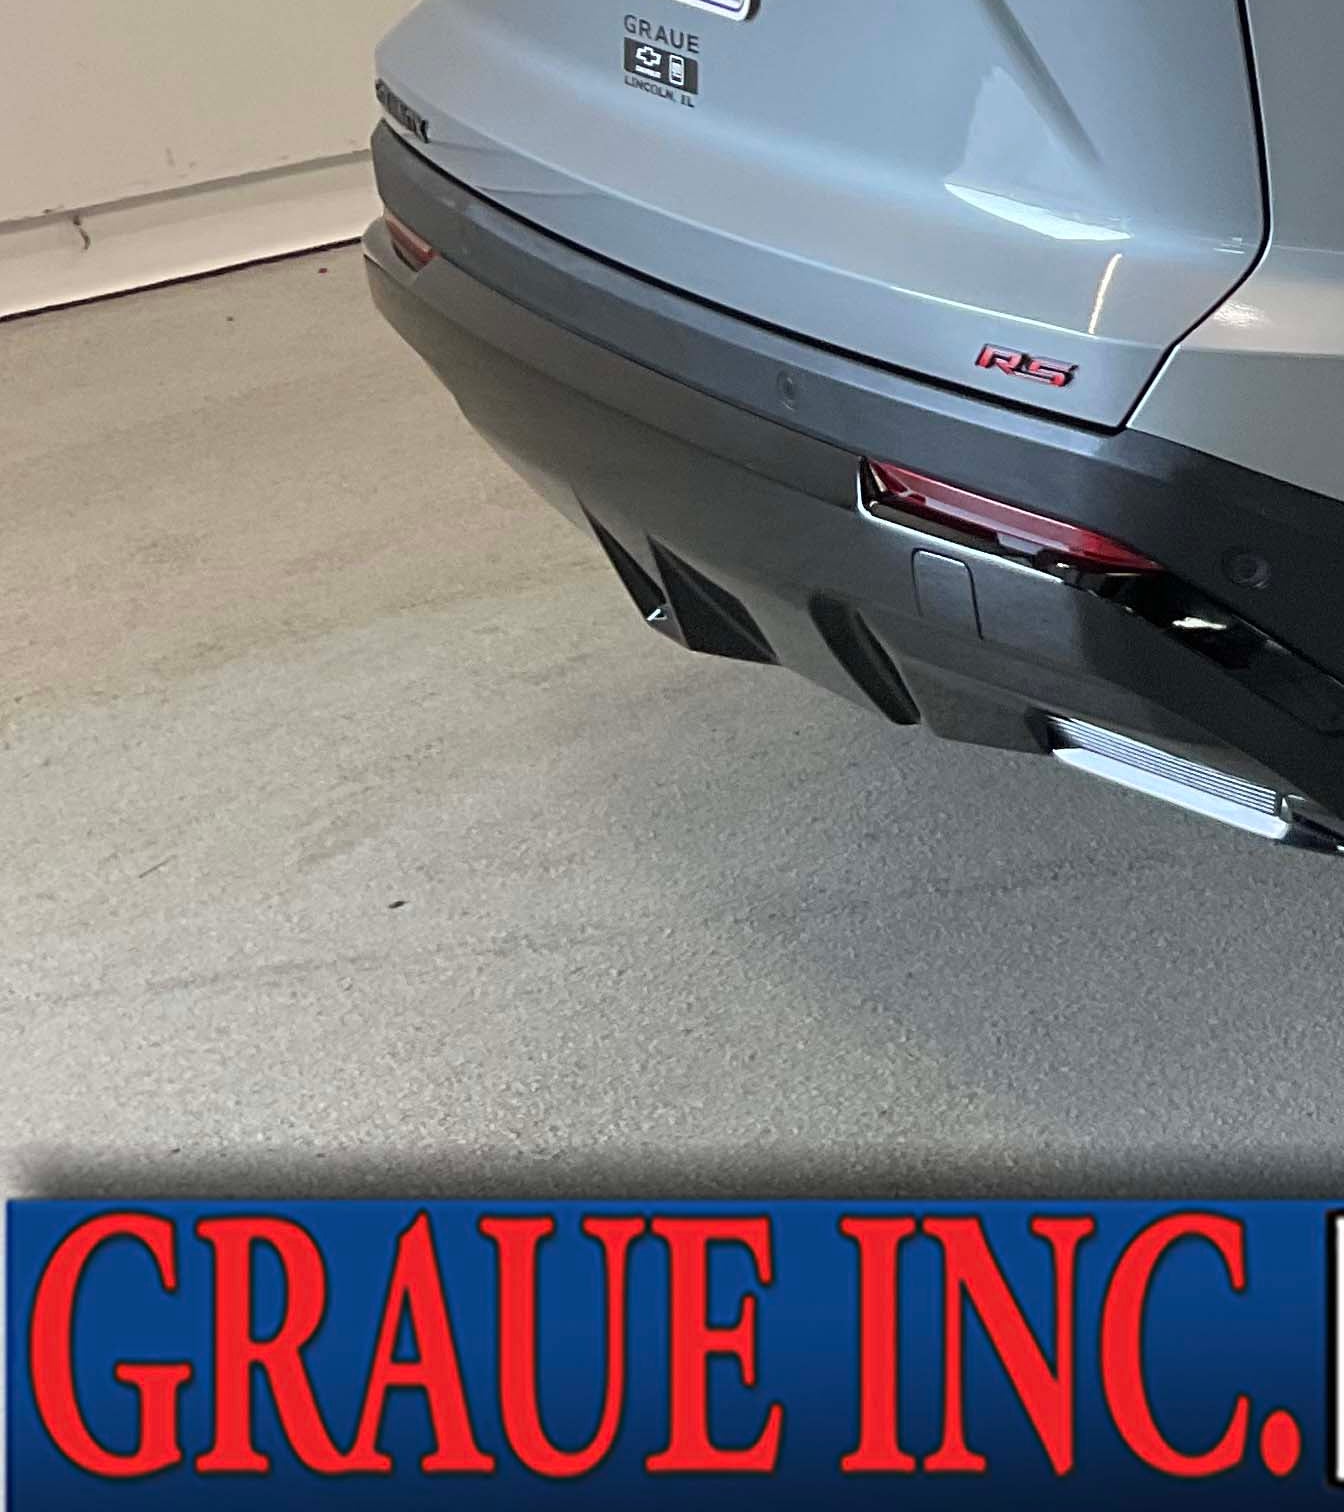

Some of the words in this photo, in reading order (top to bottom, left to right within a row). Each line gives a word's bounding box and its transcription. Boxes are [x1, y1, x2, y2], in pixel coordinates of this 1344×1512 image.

[624, 14, 700, 55] GRAUE
[681, 94, 695, 108] IL
[975, 343, 1078, 388] RS
